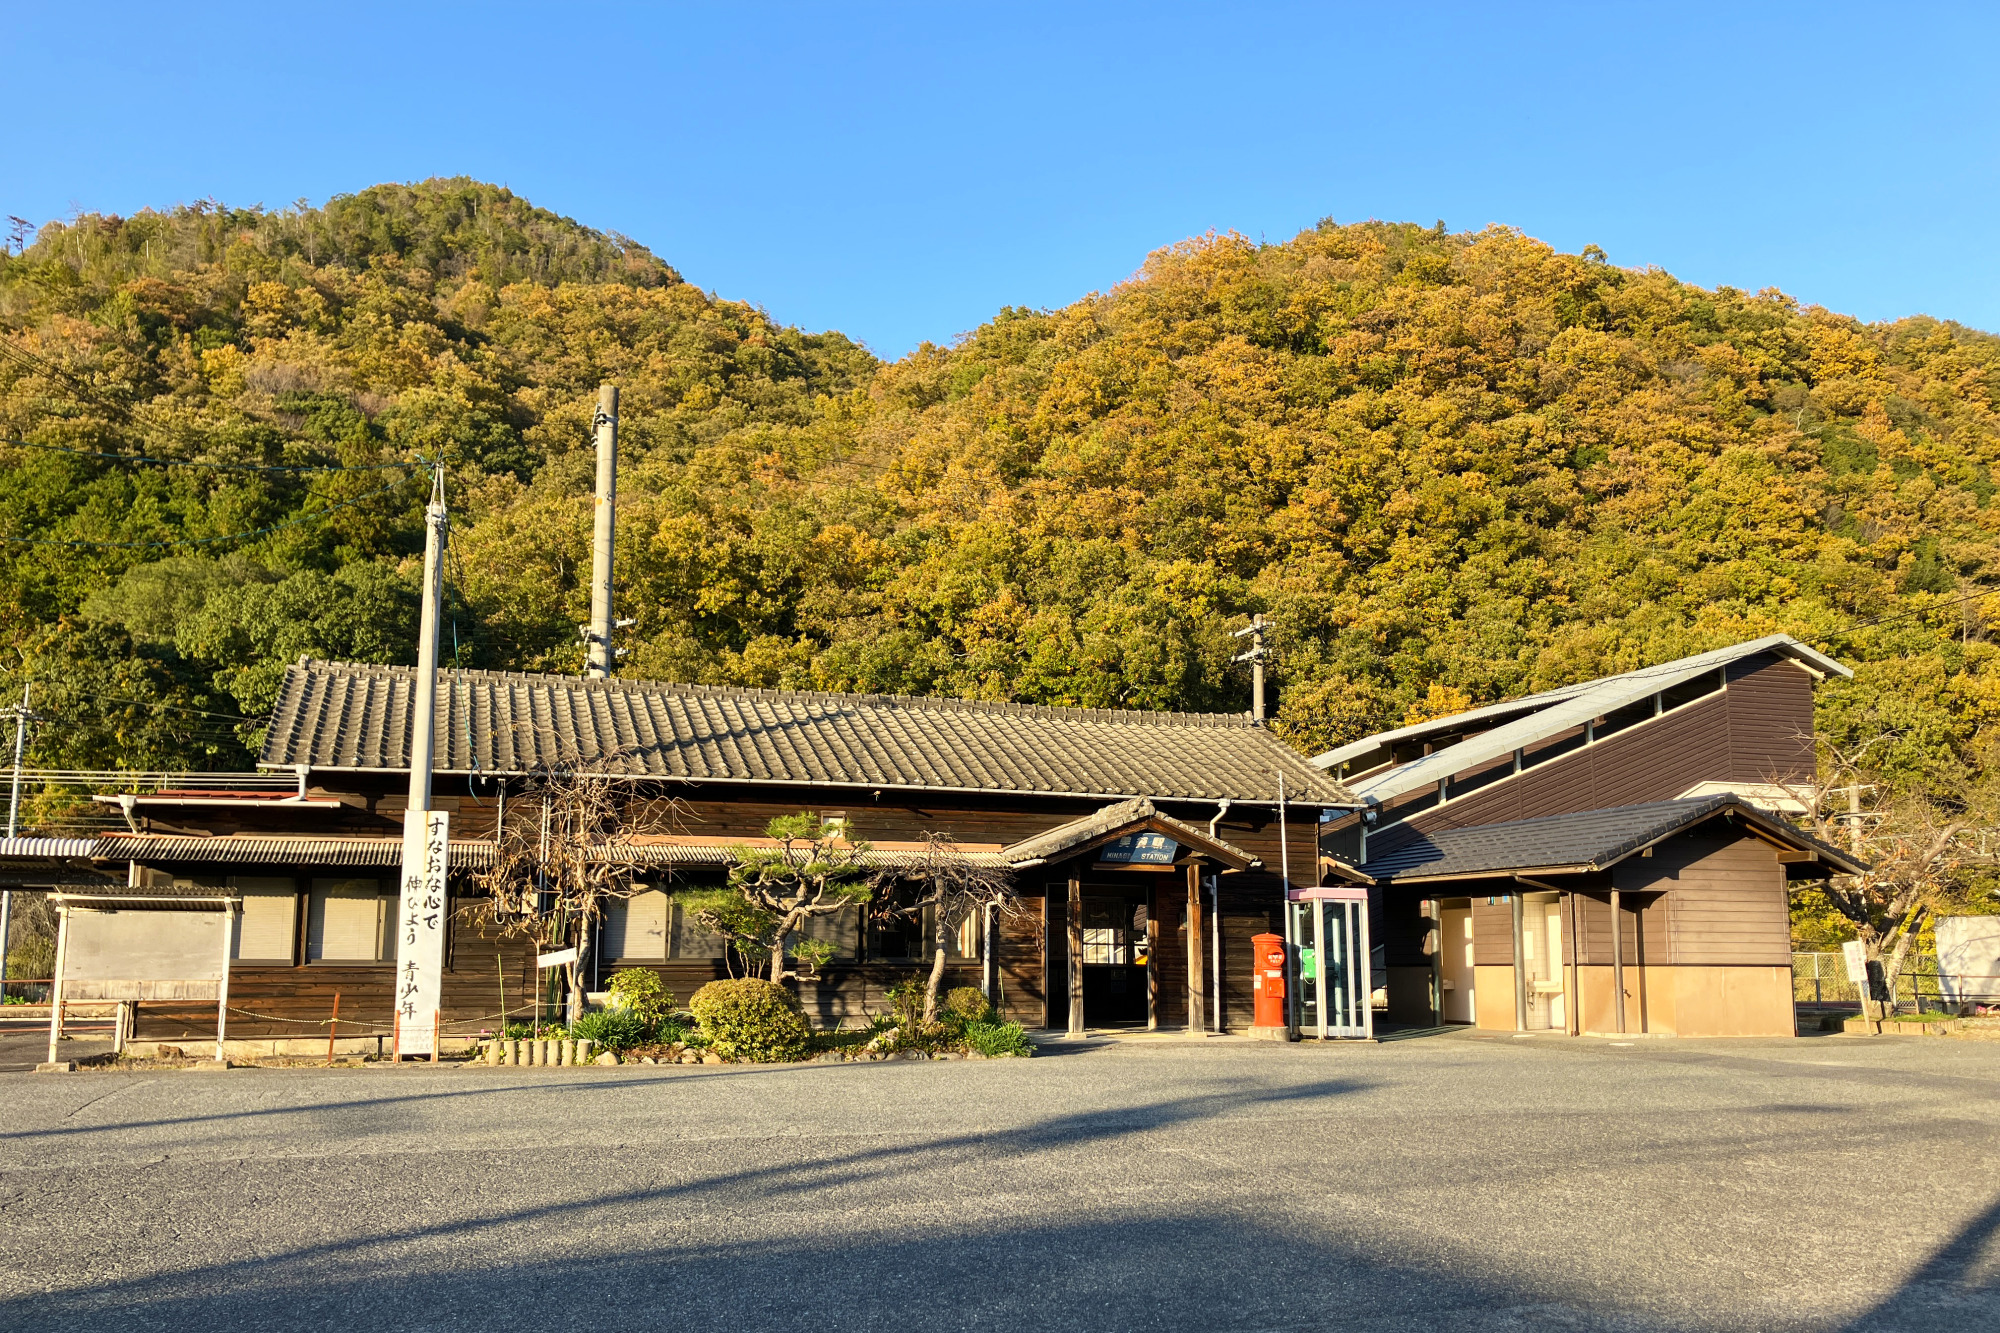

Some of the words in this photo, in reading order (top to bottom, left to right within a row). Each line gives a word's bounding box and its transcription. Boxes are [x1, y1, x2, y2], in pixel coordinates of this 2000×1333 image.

[423, 817, 444, 929] すなおな心で
[1140, 853, 1169, 861] STATION
[405, 875, 422, 945] 伸びよう
[400, 960, 420, 1020] 青少年
